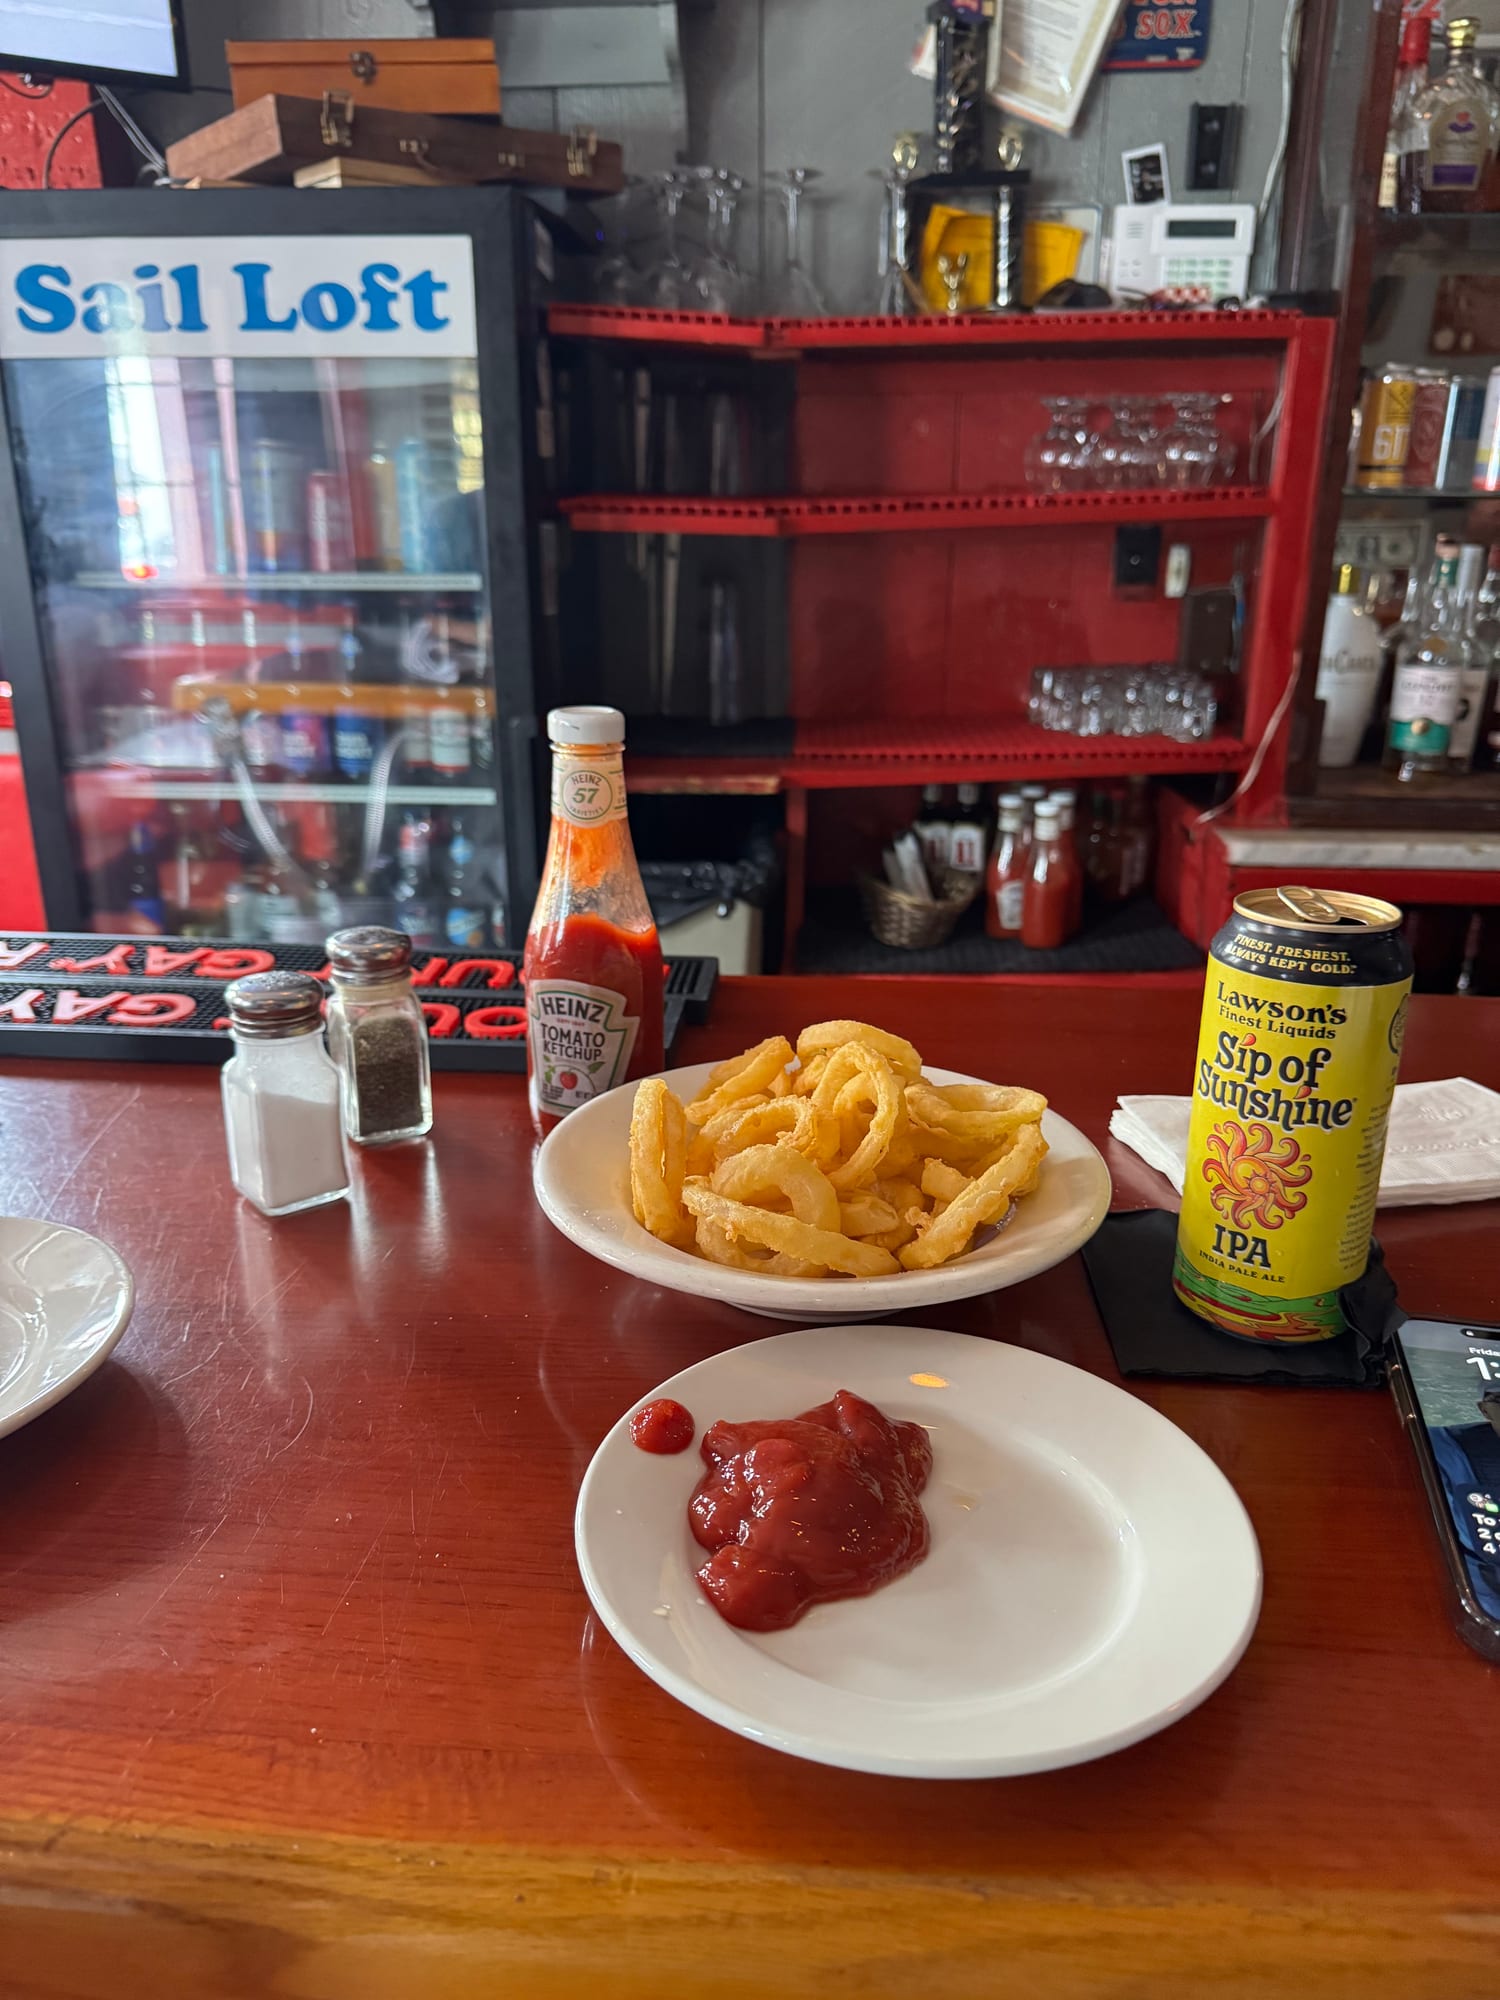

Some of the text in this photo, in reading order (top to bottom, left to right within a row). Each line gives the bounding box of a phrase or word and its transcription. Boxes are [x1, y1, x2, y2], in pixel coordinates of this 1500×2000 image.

[1134, 8, 1197, 39] SOX
[15, 262, 449, 333] Sail Loft
[570, 773, 602, 787] HEINZ
[572, 788, 599, 804] 57
[1233, 933, 1351, 962] FINEST. FRESHEST.
[1268, 956, 1307, 971] KEPT
[541, 996, 605, 1023] HEINZ
[1219, 1004, 1336, 1039] Finest Liquids
[540, 1023, 606, 1048] TOMATO
[543, 1040, 602, 1061] KETCHUP
[1214, 1030, 1332, 1088] Sip of
[1198, 1058, 1353, 1131] Sunshine
[1211, 1223, 1271, 1269] IPA
[1199, 1250, 1286, 1284] INDIA PALE ALE
[1471, 1513, 1496, 1527] To
